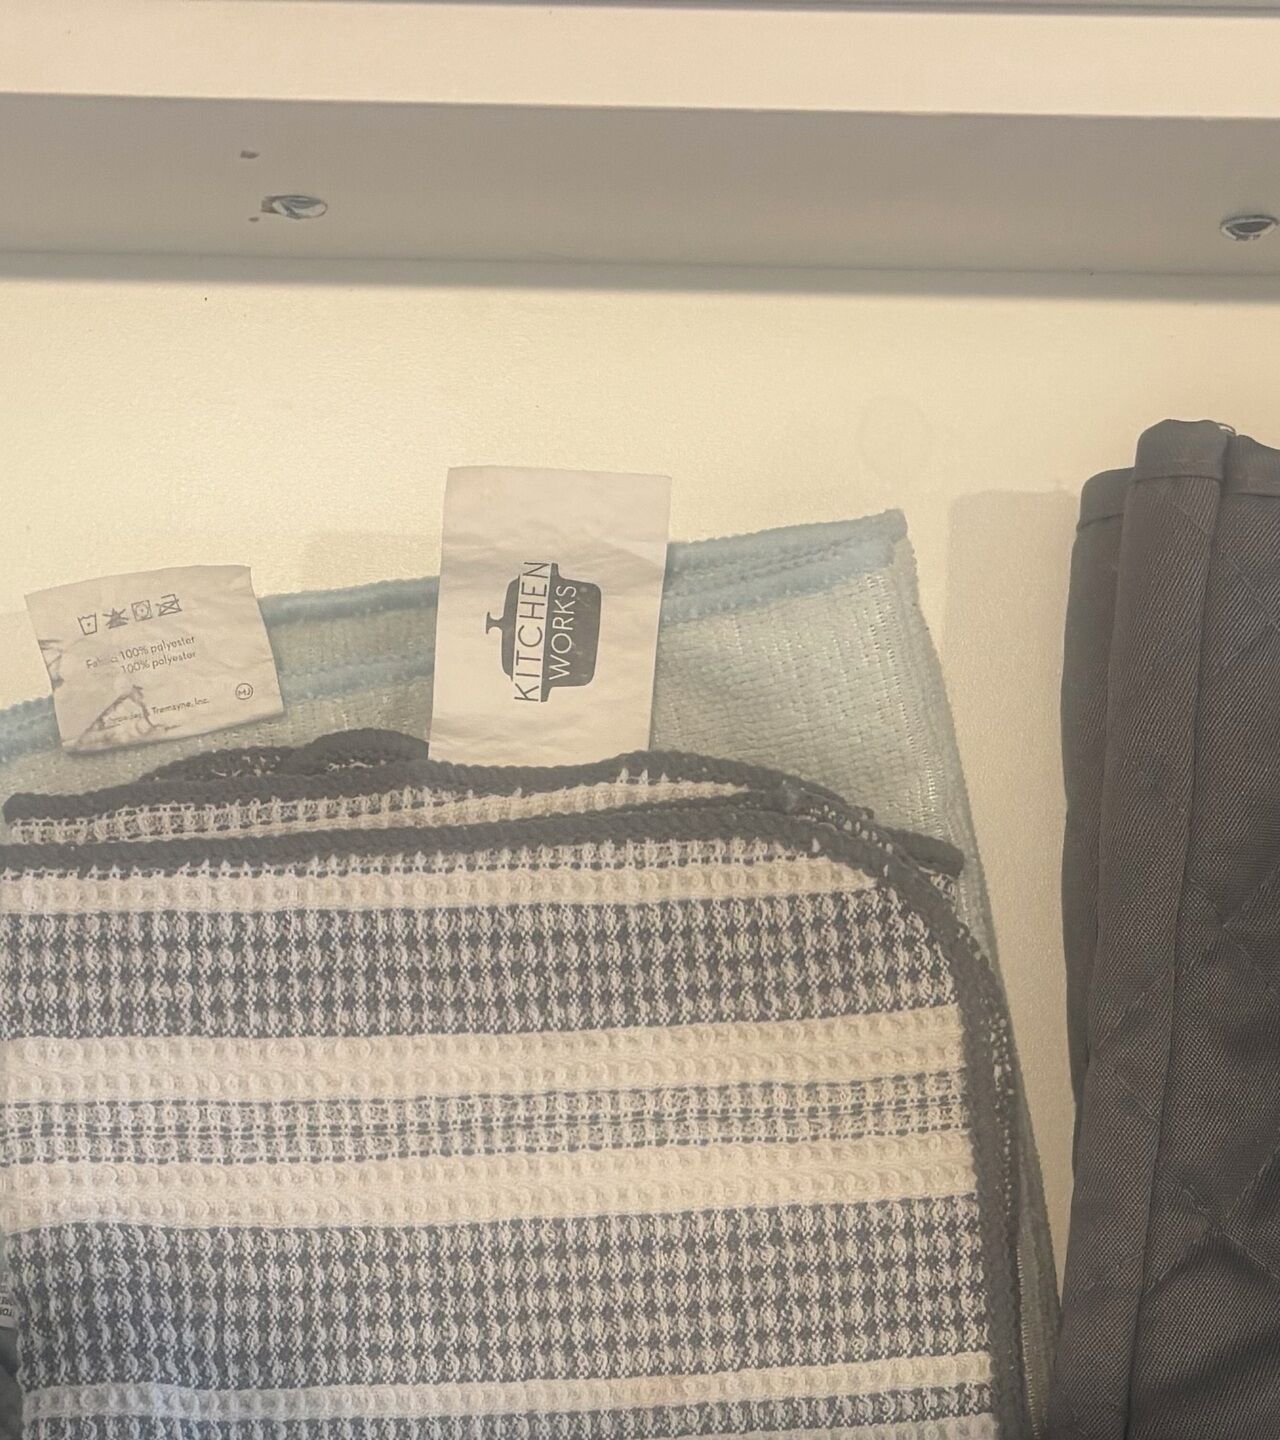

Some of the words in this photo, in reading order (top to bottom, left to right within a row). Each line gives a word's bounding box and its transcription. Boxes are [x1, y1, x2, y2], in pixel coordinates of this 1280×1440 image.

[120, 647, 149, 661] 100%
[513, 561, 549, 702] KITCHEN
[548, 585, 577, 680] WORKS
[121, 661, 150, 673] 100%
